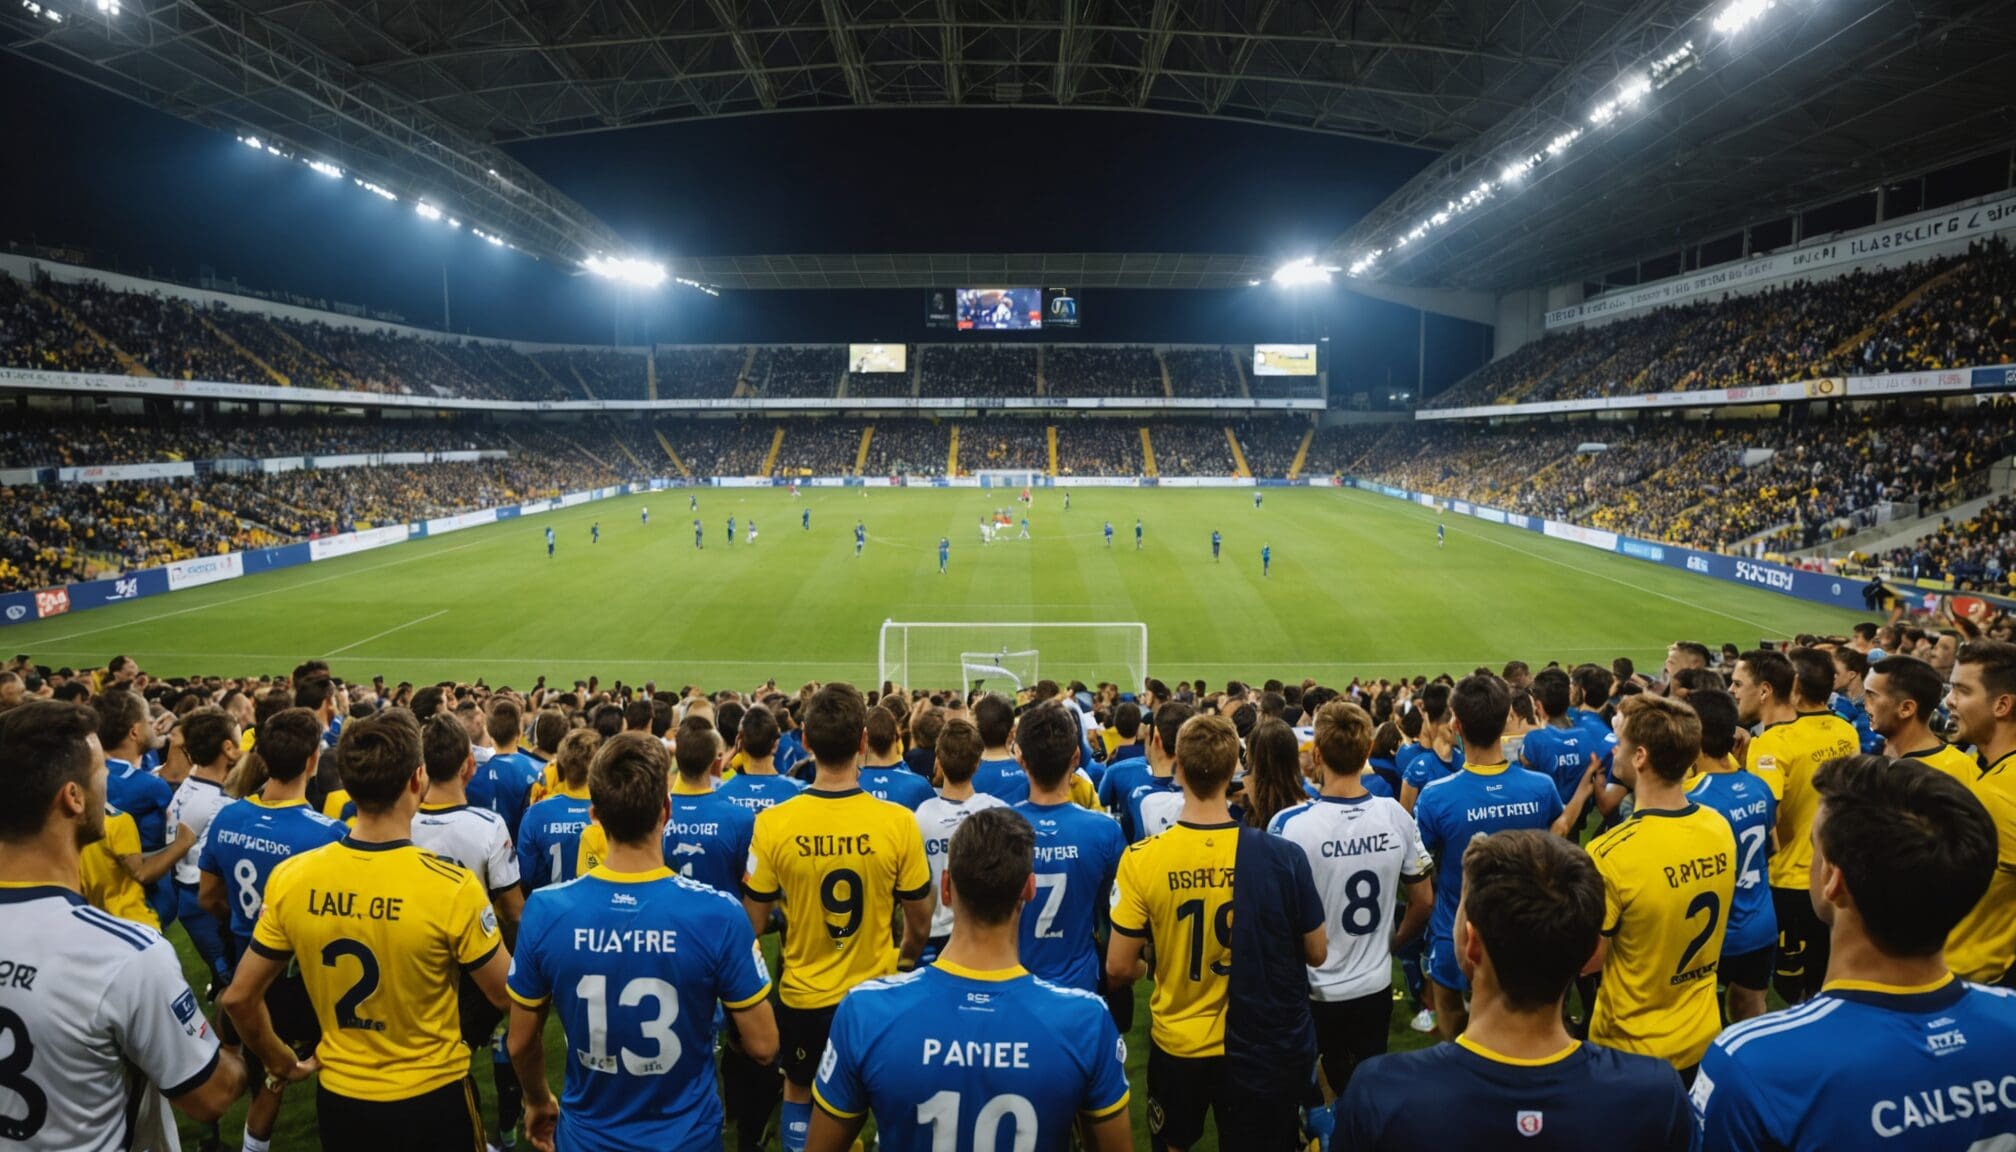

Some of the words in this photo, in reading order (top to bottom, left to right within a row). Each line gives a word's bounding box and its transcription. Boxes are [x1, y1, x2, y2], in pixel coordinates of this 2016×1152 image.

[233, 858, 262, 919] 8
[820, 868, 864, 939] 9
[1342, 869, 1381, 937] 8
[1177, 898, 1234, 982] 19
[320, 937, 380, 1031] 2
[576, 974, 683, 1077] 13
[917, 1090, 1039, 1152] 10
